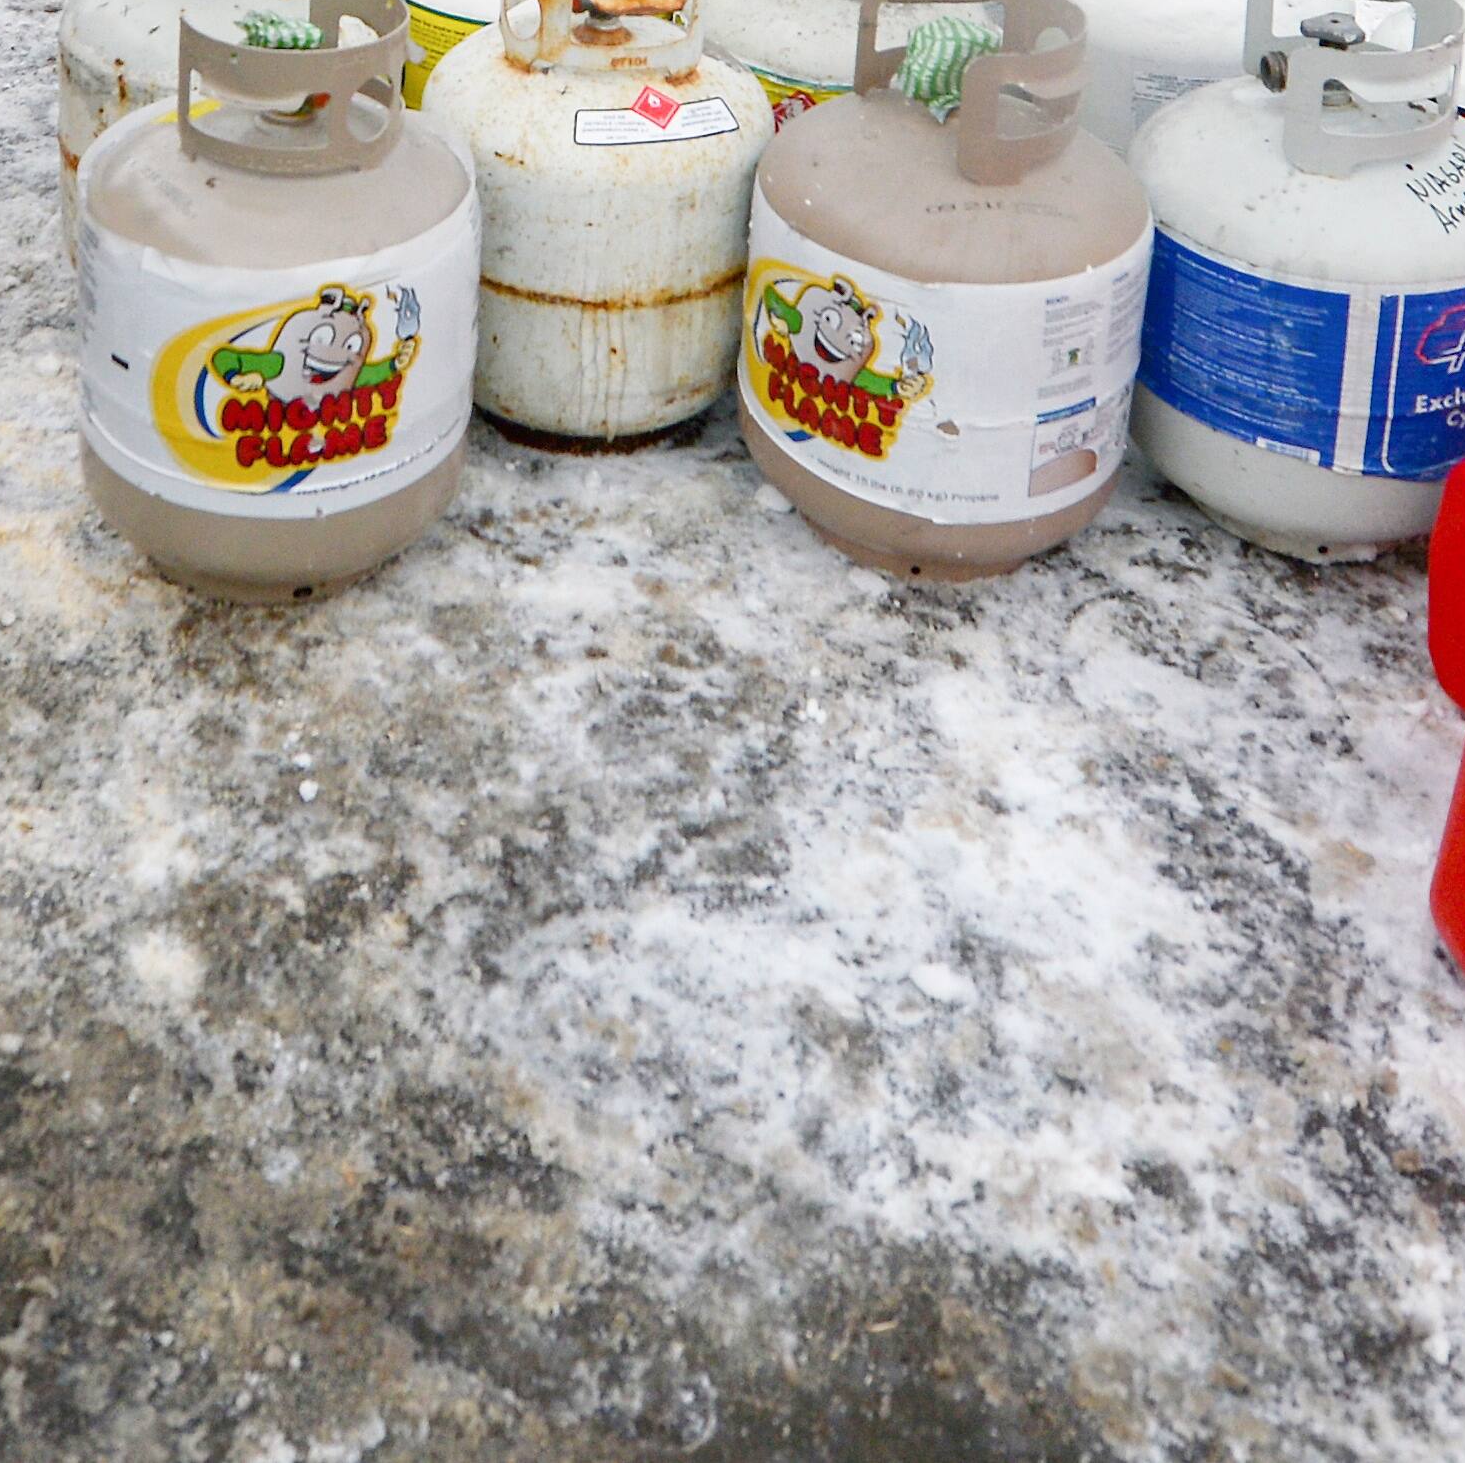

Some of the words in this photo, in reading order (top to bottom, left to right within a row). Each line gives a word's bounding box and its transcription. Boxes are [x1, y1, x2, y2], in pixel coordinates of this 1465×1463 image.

[221, 373, 403, 434] MIGHTY
[763, 333, 905, 428] MIGHTY
[768, 370, 884, 457] FLAME
[236, 414, 388, 468] FLAME
